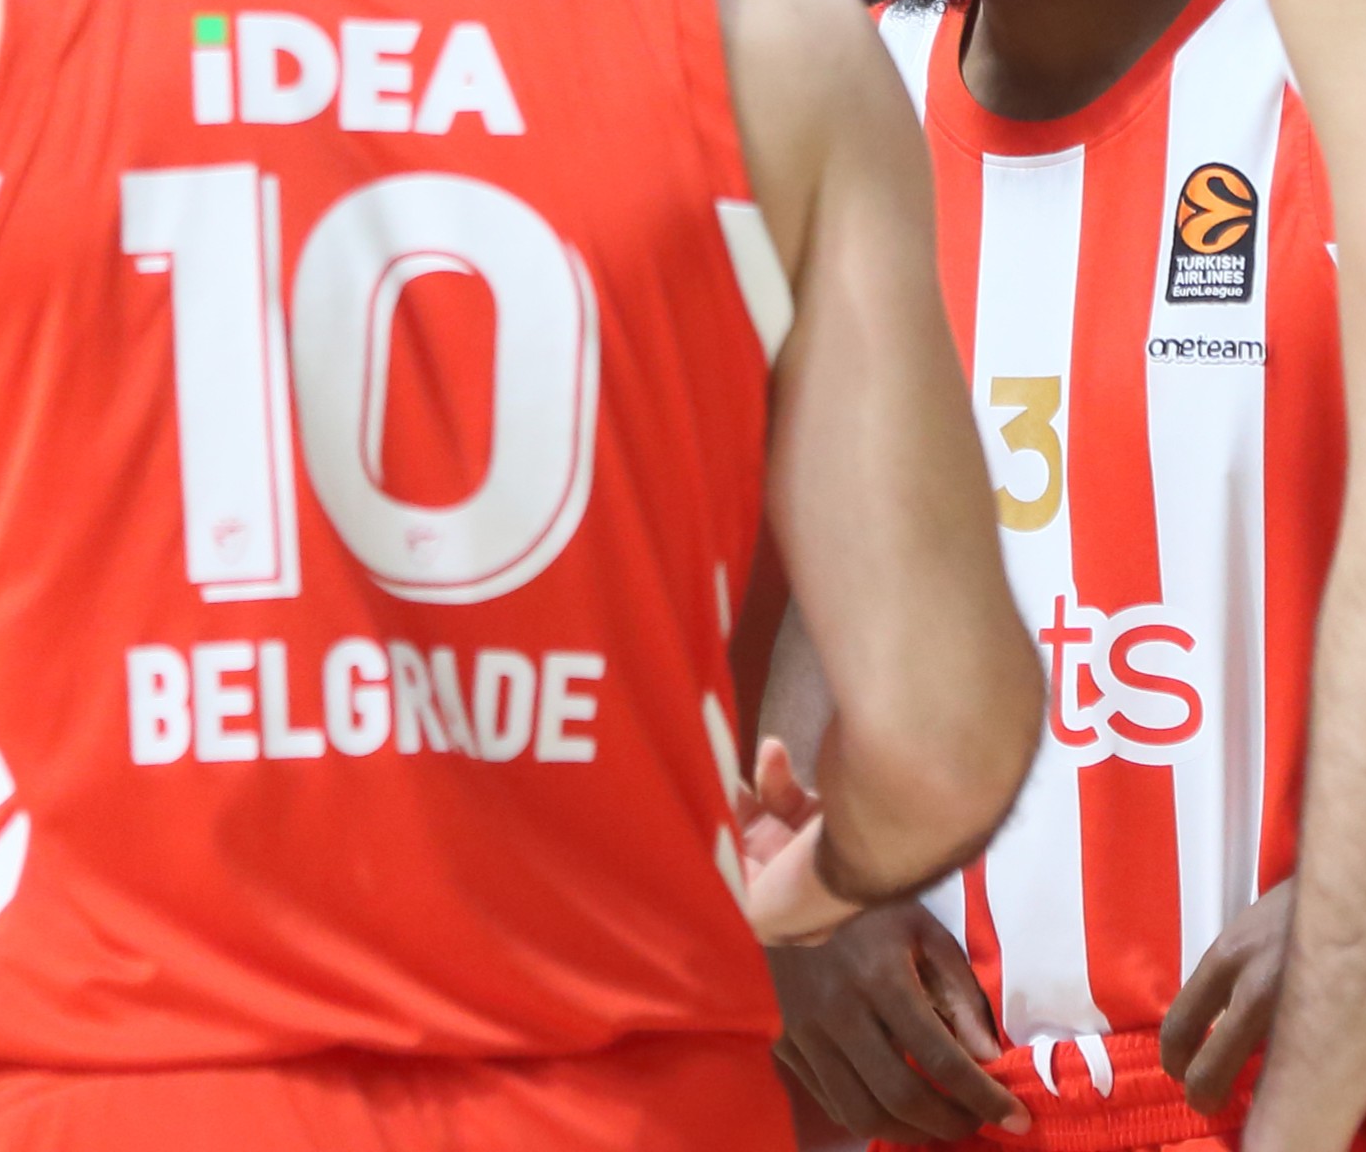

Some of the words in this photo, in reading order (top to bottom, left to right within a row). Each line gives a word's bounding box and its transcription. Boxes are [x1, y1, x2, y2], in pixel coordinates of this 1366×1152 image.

[1176, 255, 1246, 271] TURKISH
[1174, 270, 1245, 286] AIRLINES
[1172, 286, 1244, 299] EuroLeague
[121, 162, 601, 605] 10
[126, 635, 607, 766] BELGRADE
